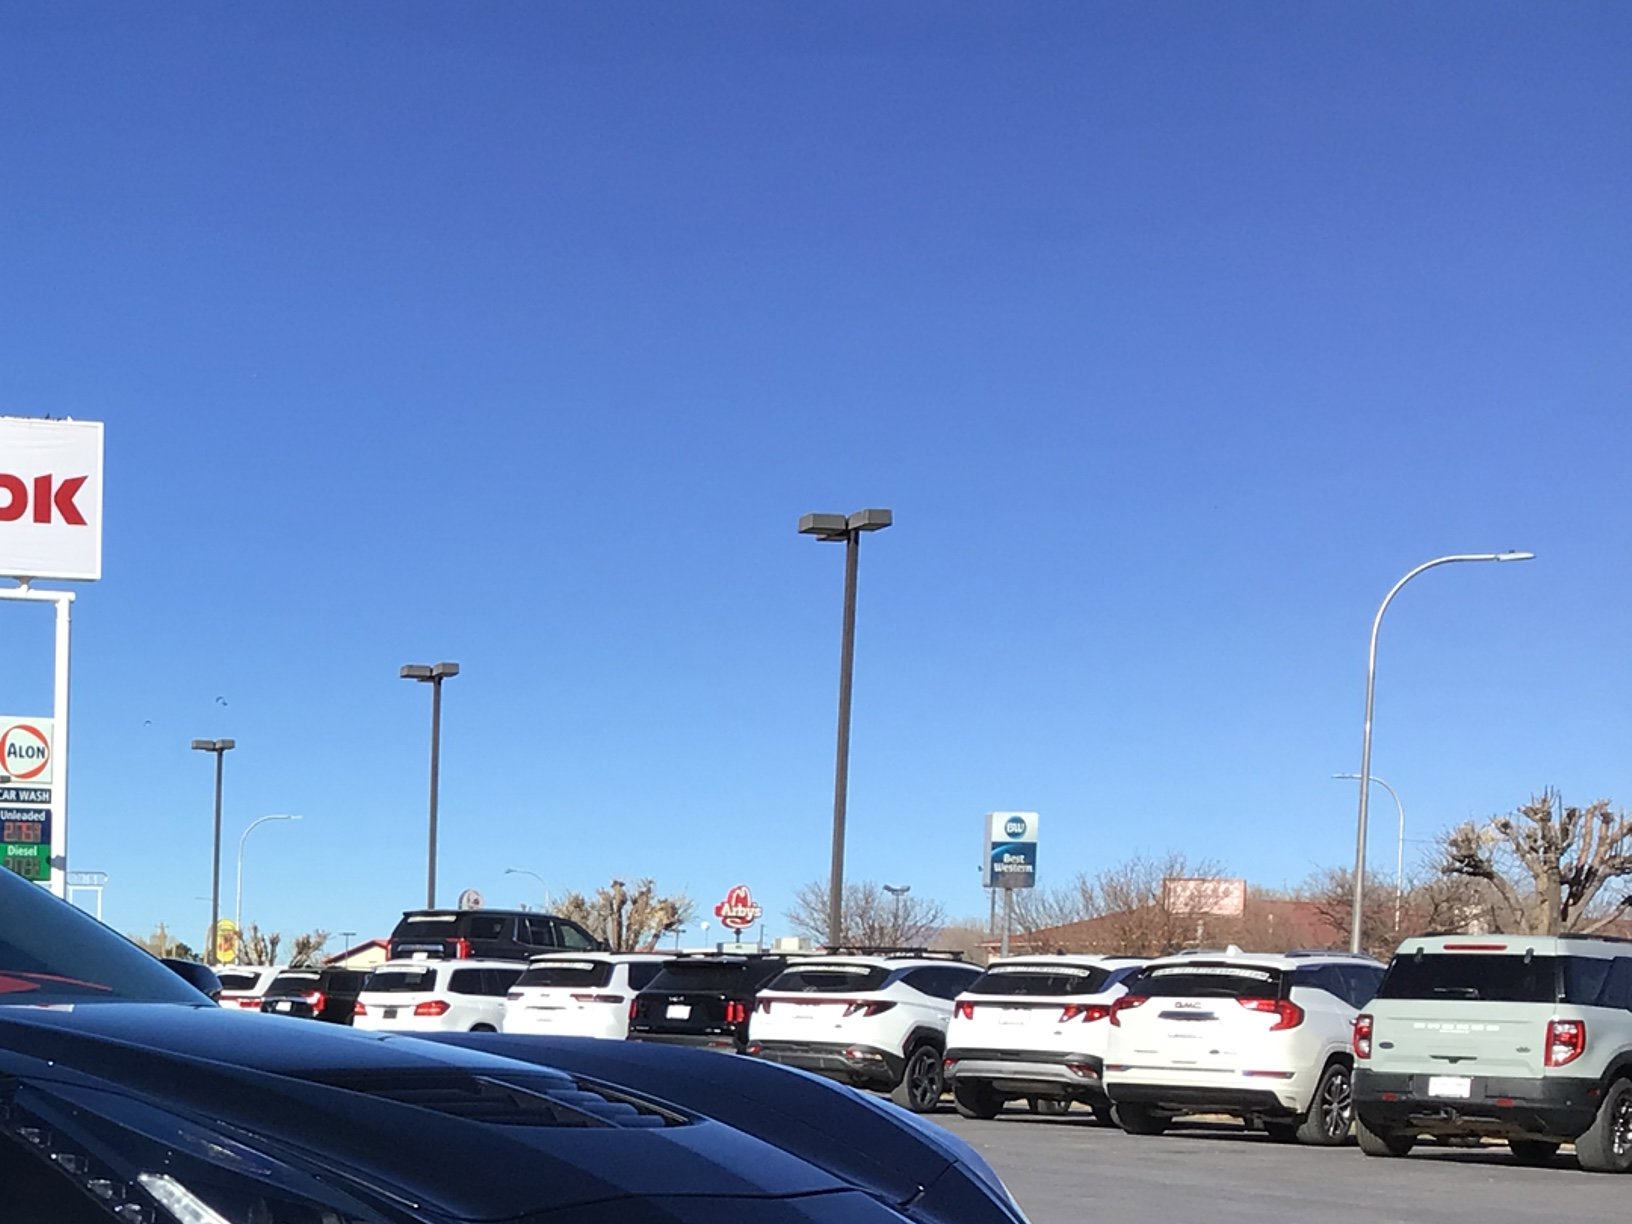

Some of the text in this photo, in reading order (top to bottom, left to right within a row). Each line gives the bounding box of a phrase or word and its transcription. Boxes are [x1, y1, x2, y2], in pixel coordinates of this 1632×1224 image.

[7, 743, 45, 758] ALON
[19, 790, 49, 801] WASH
[0, 811, 45, 821] Unleaded
[7, 845, 37, 856] Diesel
[1003, 853, 1025, 863] Best
[994, 863, 1033, 872] Western
